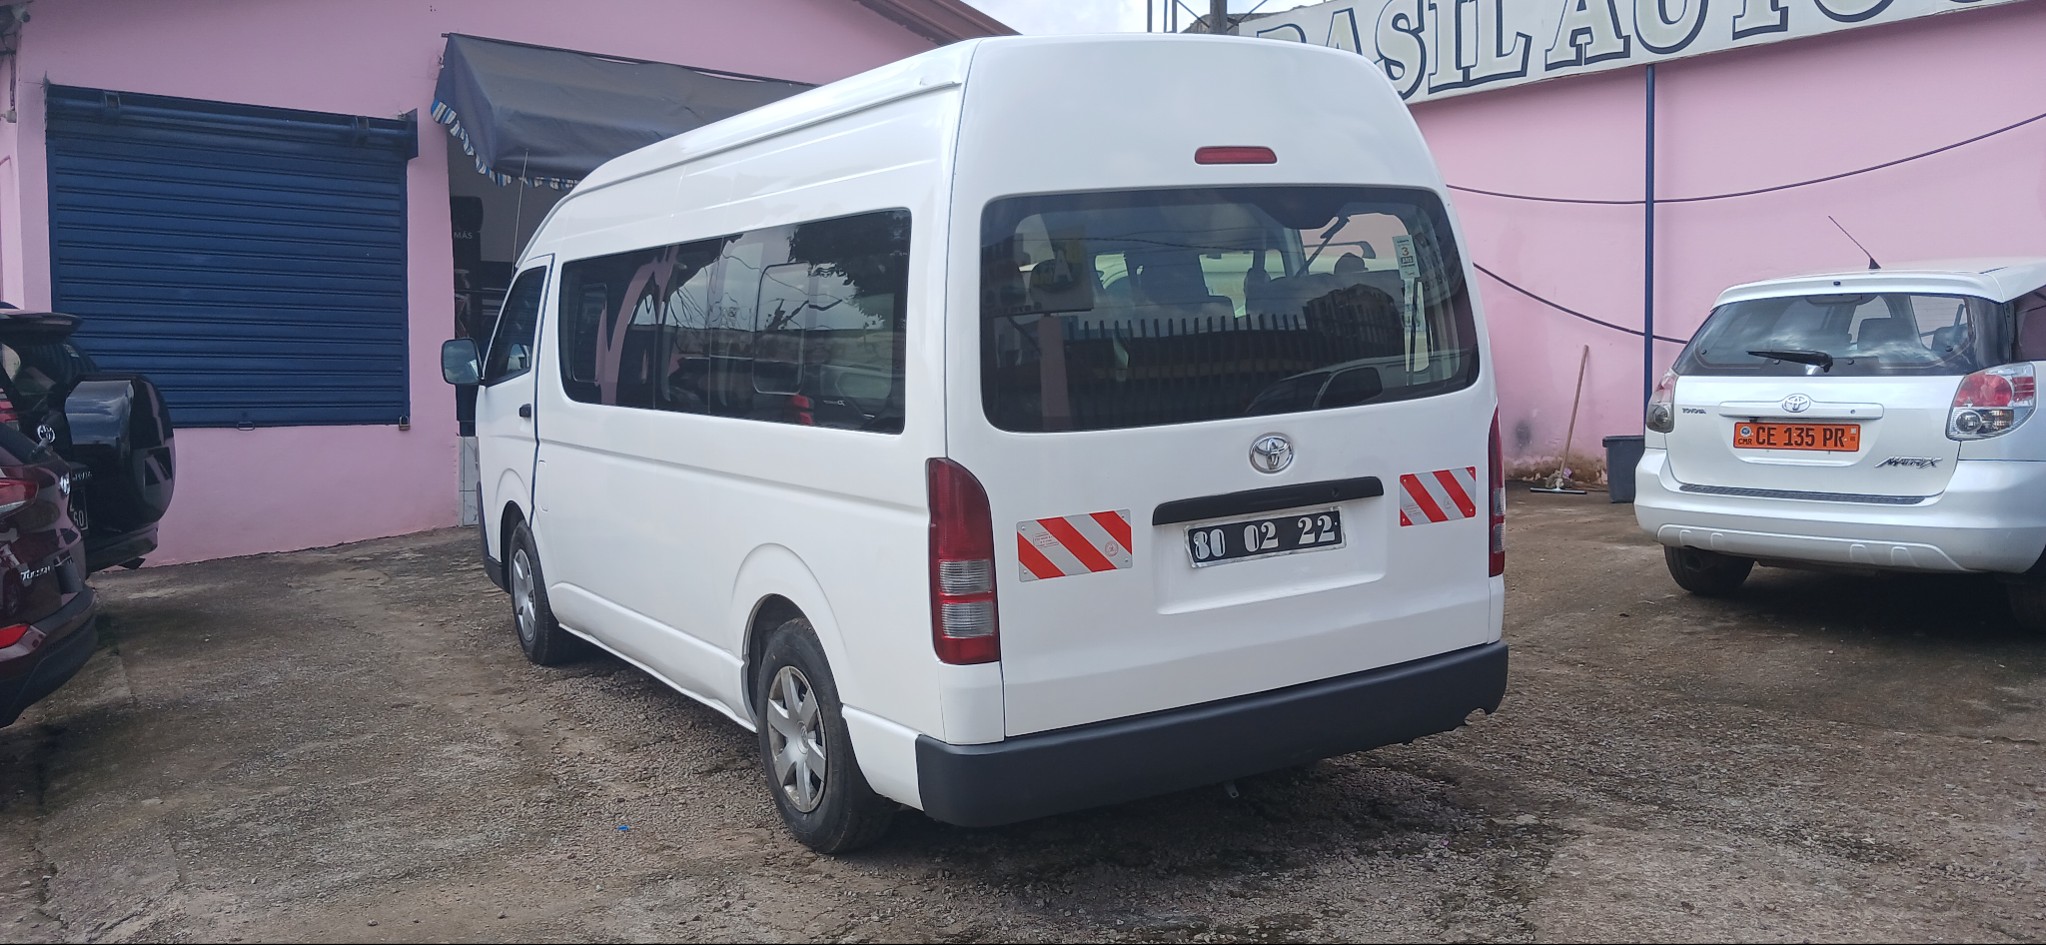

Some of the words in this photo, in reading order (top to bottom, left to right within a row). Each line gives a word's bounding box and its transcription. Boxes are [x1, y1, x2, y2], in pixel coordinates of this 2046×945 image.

[1545, 0, 1890, 71] AU
[1401, 246, 1410, 257] 3
[1737, 437, 1753, 446] CMR
[1755, 426, 1777, 446] CE
[1783, 426, 1816, 447] 135
[1822, 427, 1845, 448] PR
[1193, 528, 1226, 560] 80
[1243, 521, 1279, 552] 02
[1297, 514, 1336, 545] 22
